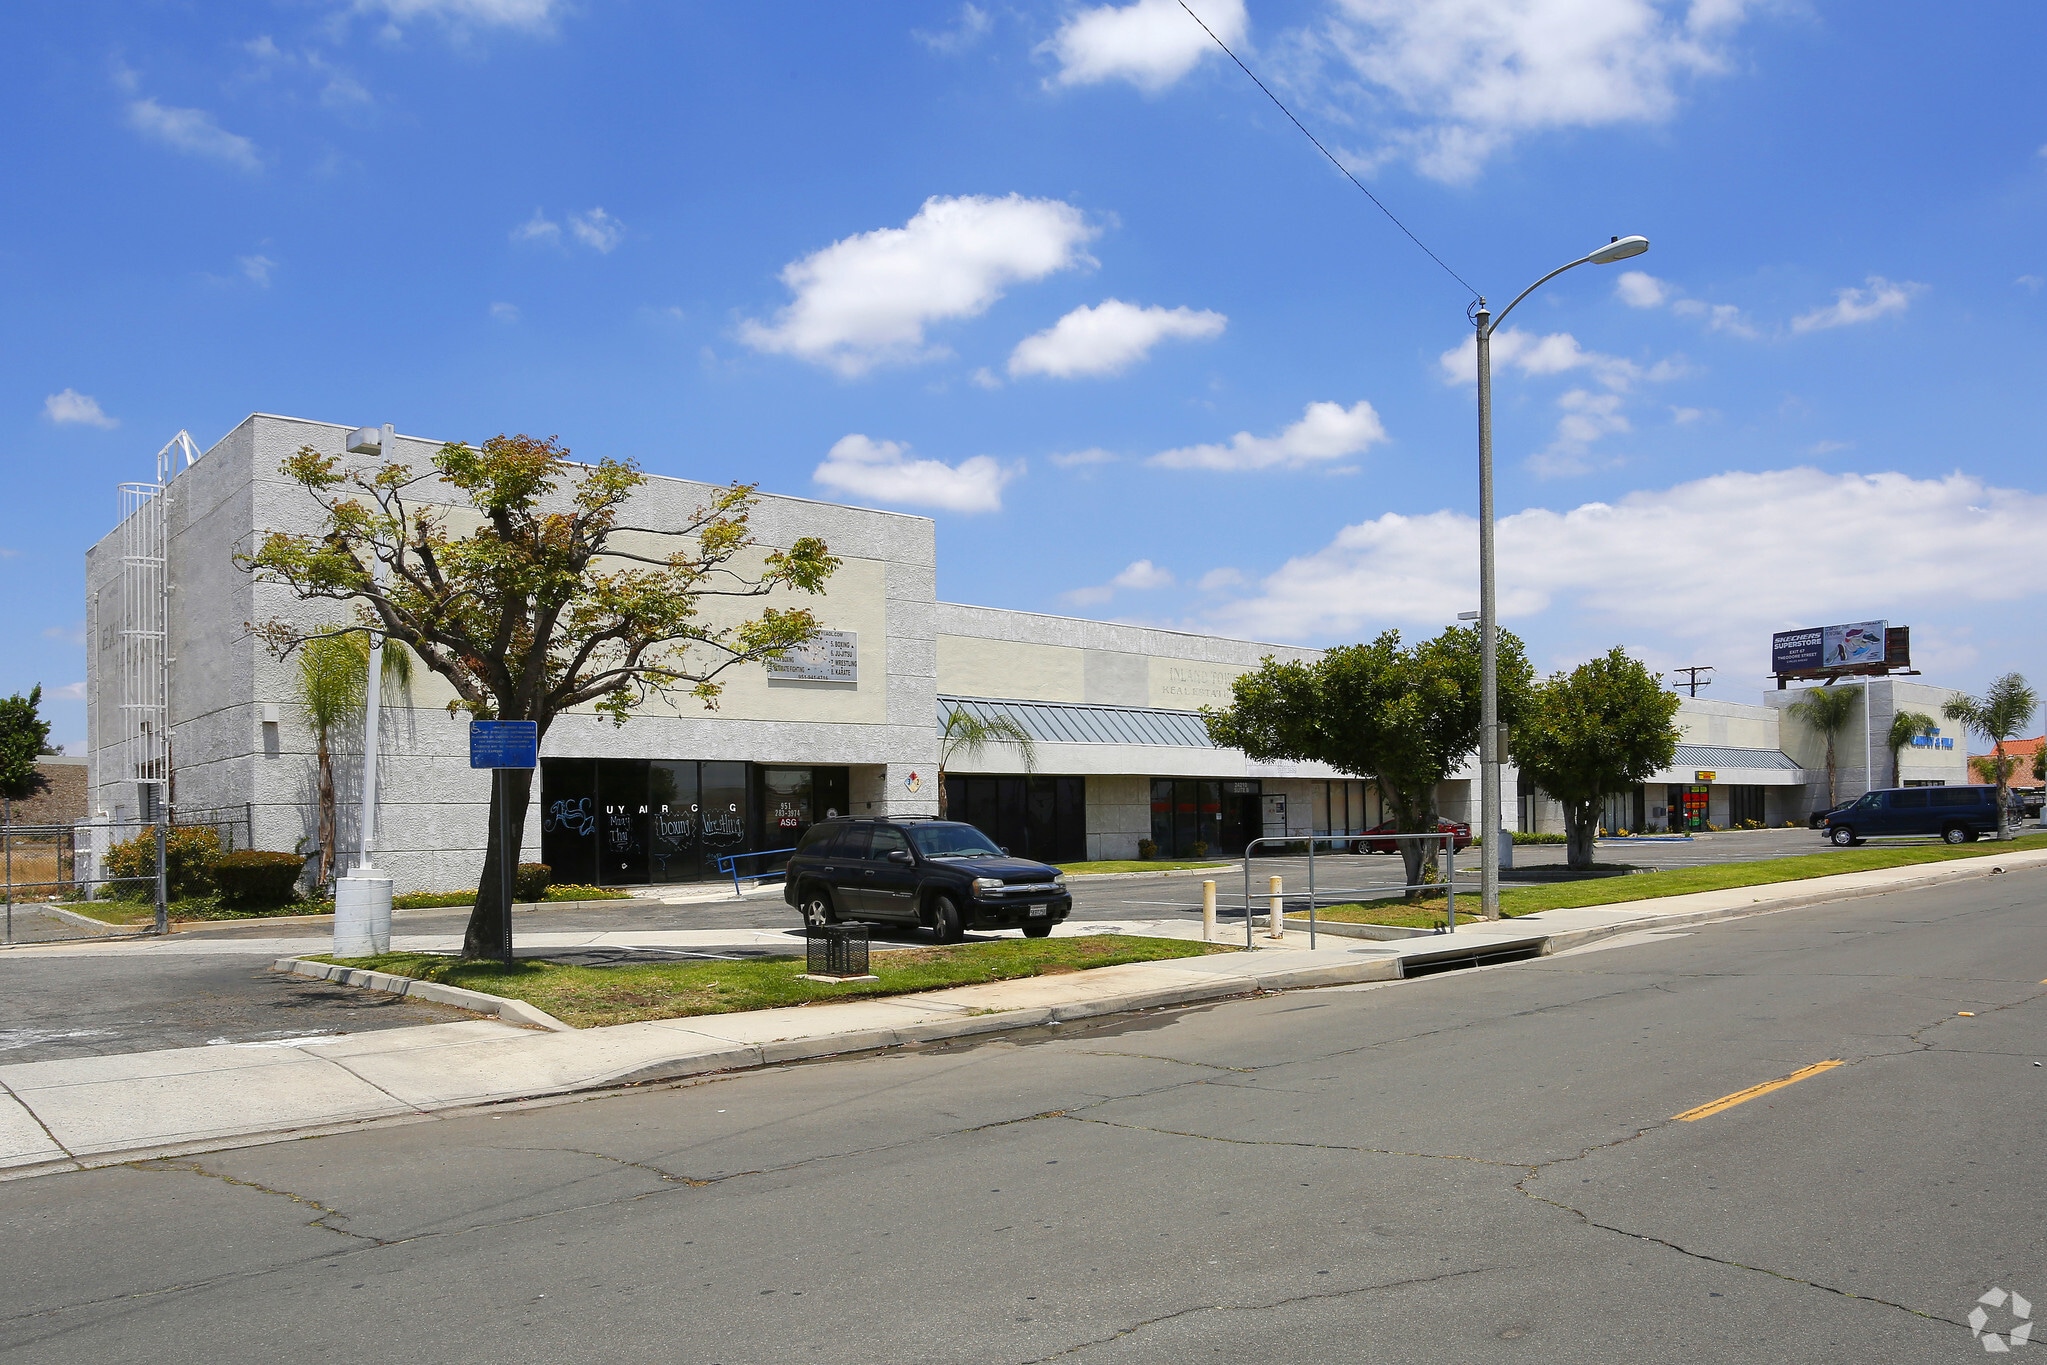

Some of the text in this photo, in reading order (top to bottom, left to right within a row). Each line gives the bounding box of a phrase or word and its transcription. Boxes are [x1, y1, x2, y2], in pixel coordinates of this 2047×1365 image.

[1774, 632, 1822, 644] SKECHERS
[1774, 638, 1822, 650] SUPERSTORE
[835, 660, 857, 668] WRESTLING
[1169, 667, 1207, 684] INLAND
[1163, 685, 1231, 699] REAL ESTATE
[916, 778, 921, 786] 2
[780, 802, 792, 810] 951
[774, 808, 800, 817] 283-3974
[659, 816, 690, 837] boxing
[780, 819, 797, 827] ASG
